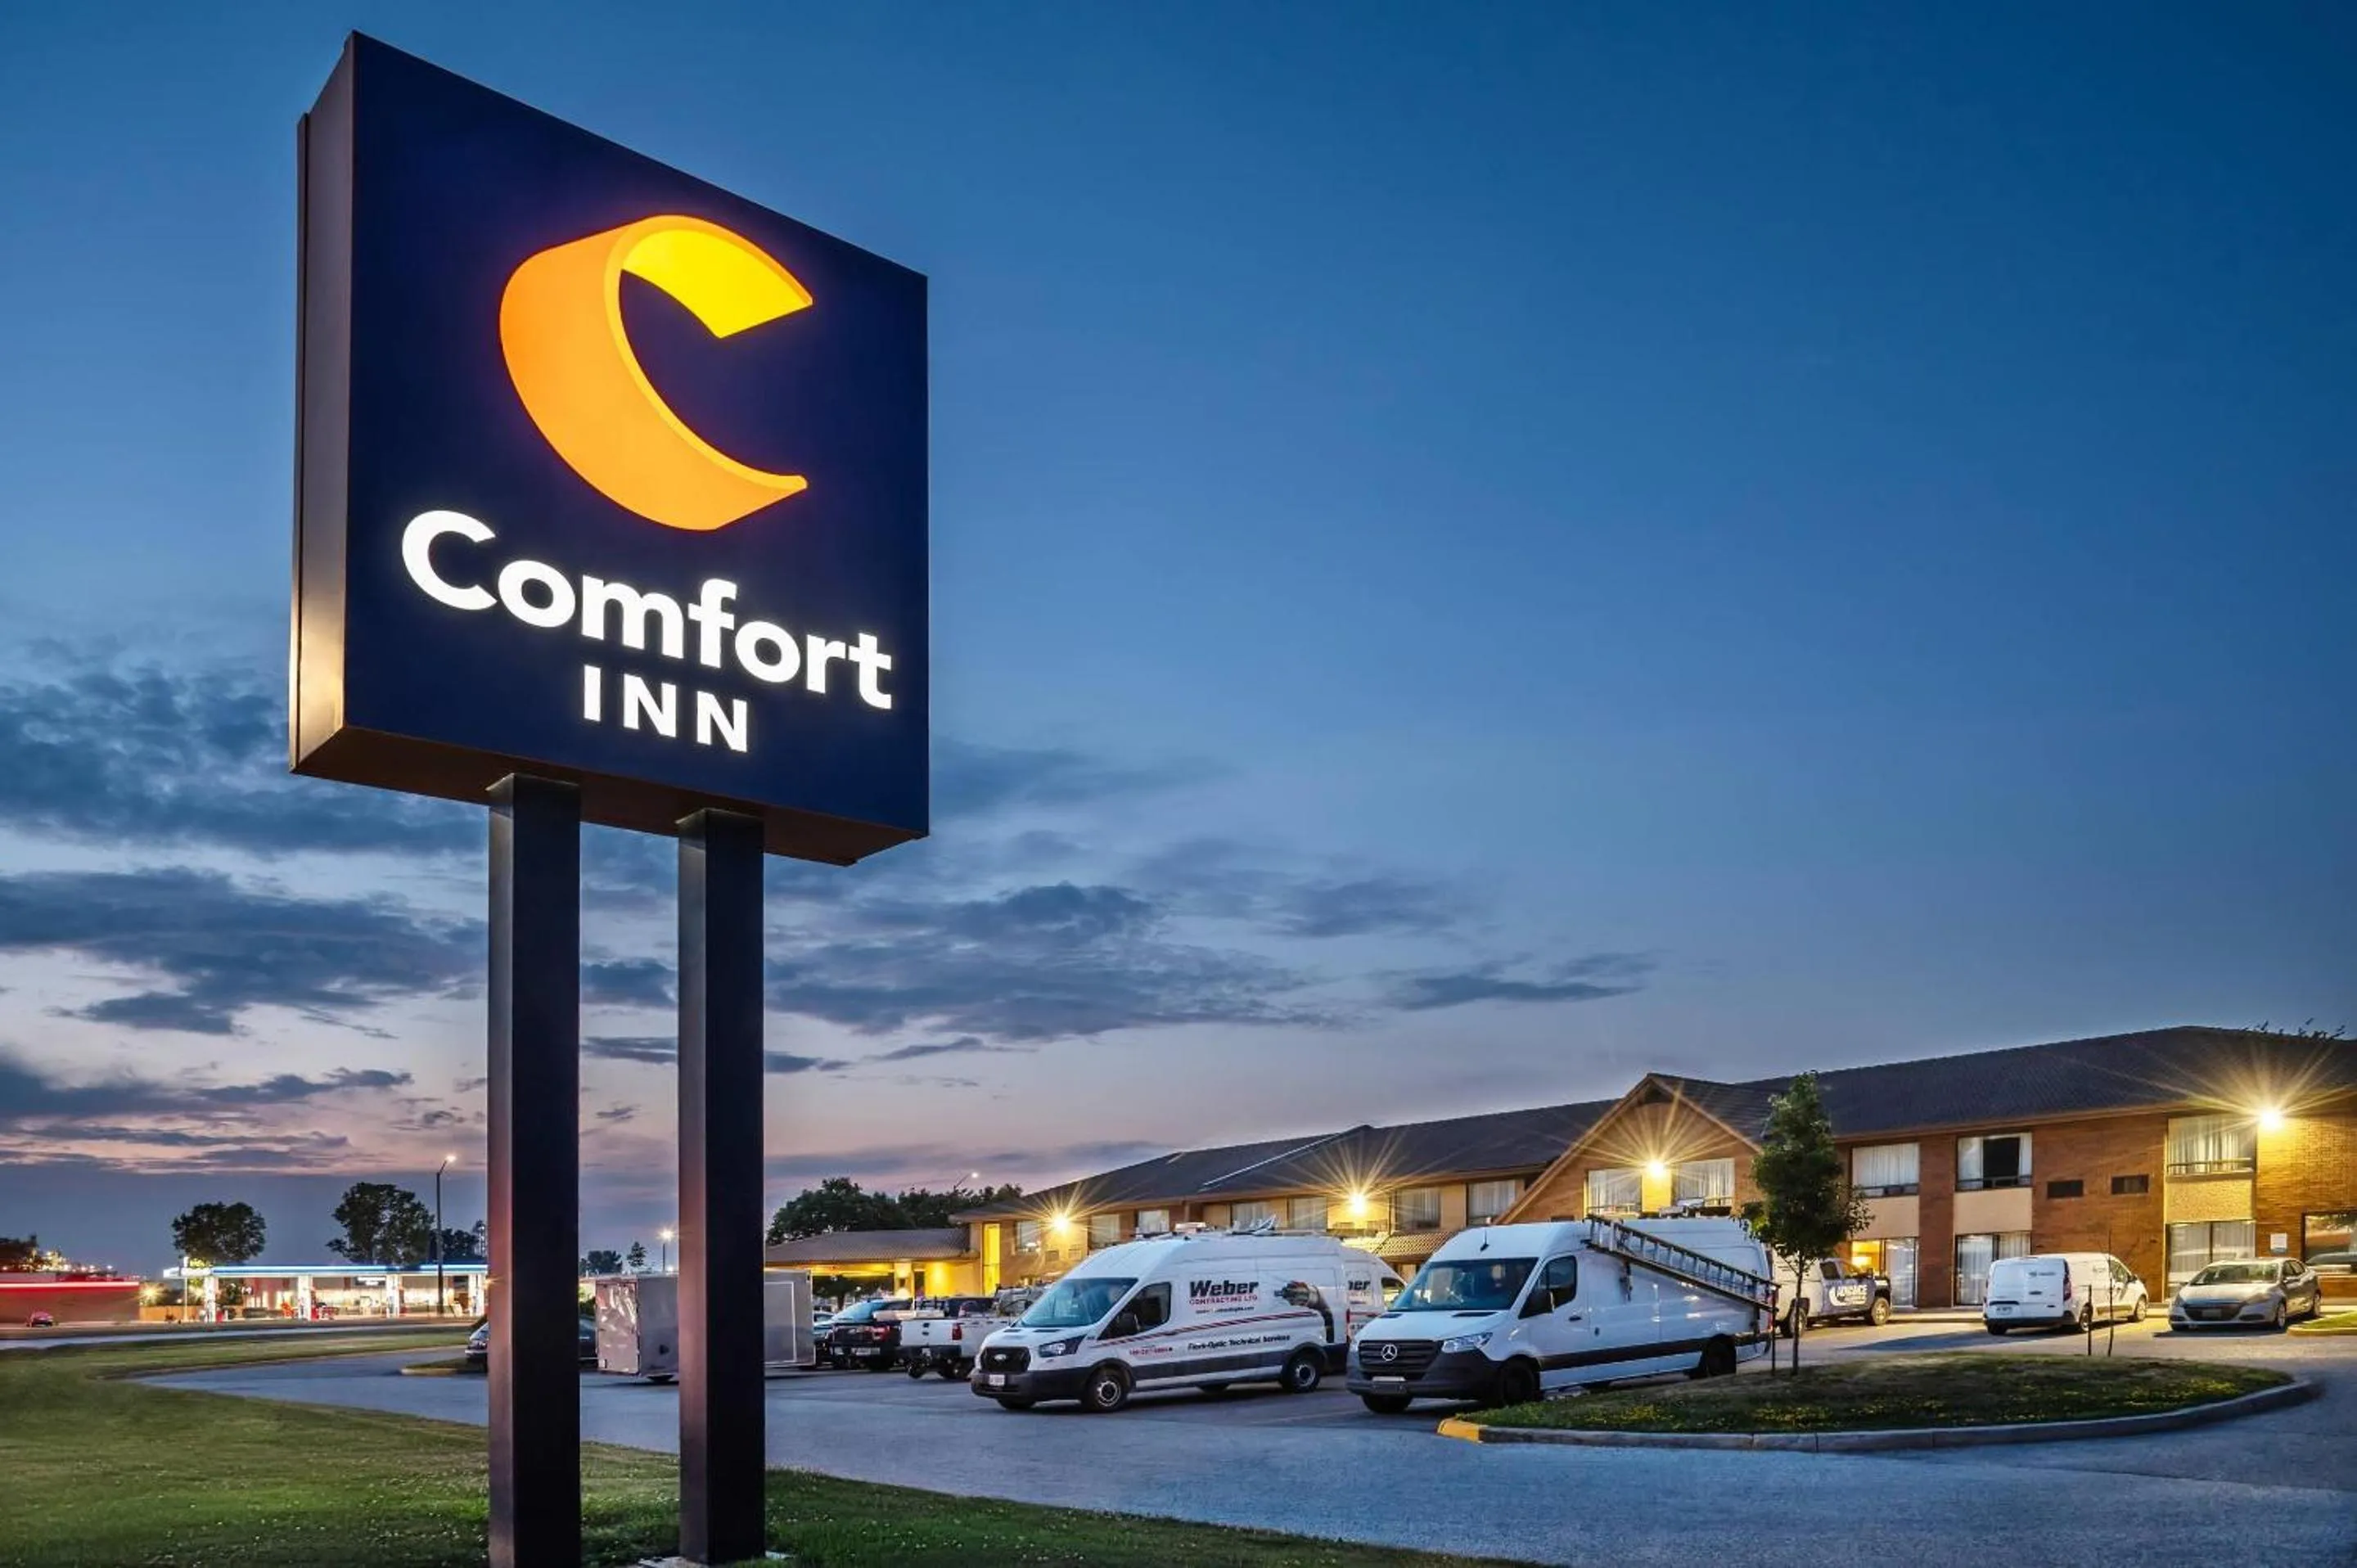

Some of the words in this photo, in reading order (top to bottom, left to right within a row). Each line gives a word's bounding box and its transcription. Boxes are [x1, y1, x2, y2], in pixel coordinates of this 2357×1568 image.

[402, 510, 892, 710] Comfort
[584, 664, 748, 753] INN
[1189, 1280, 1259, 1297] Weber
